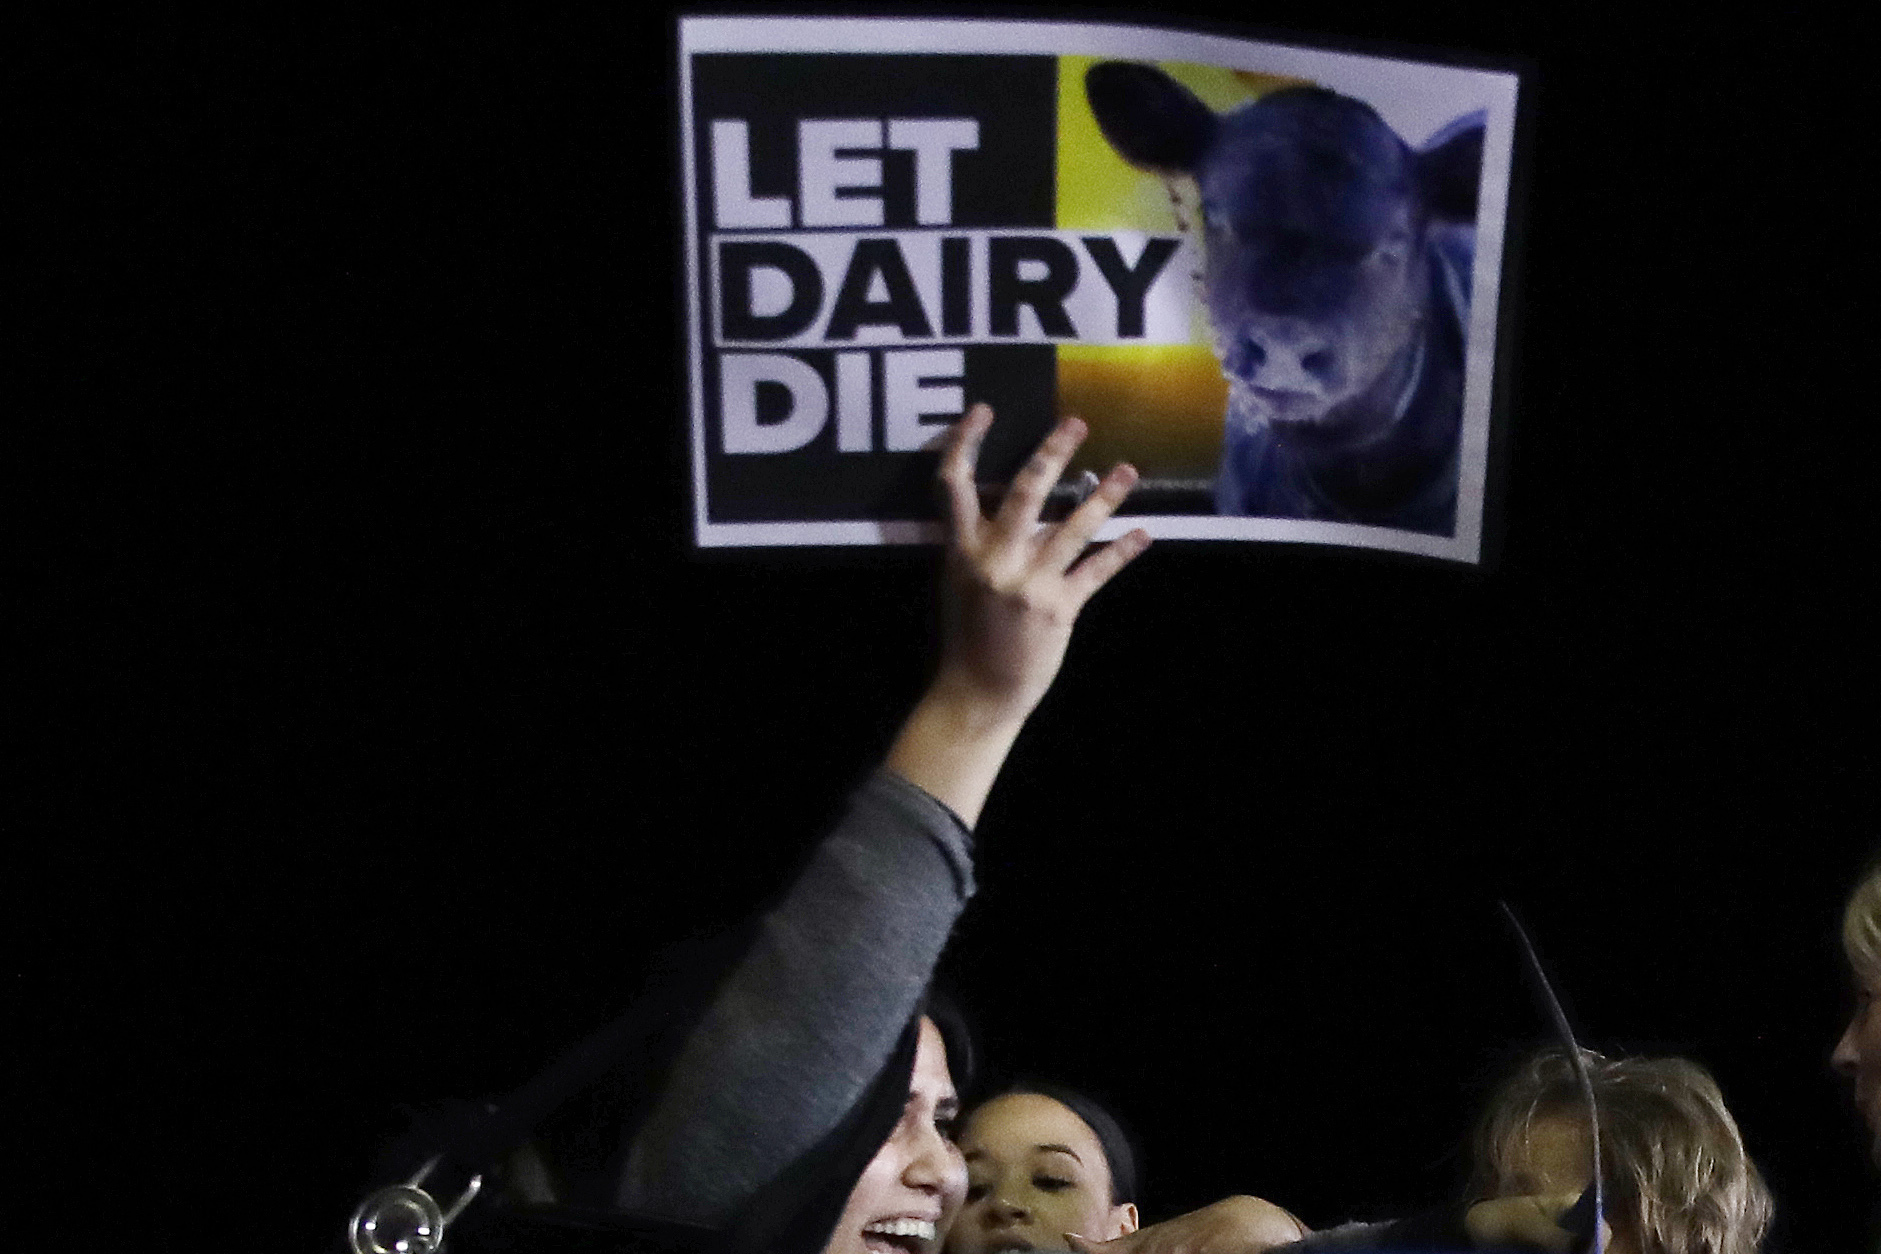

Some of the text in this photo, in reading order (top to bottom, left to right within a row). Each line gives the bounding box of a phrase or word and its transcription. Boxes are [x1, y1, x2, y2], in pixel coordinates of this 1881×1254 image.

[711, 118, 979, 229] LET
[716, 236, 1182, 343] DAIRY
[721, 350, 965, 454] DIE
